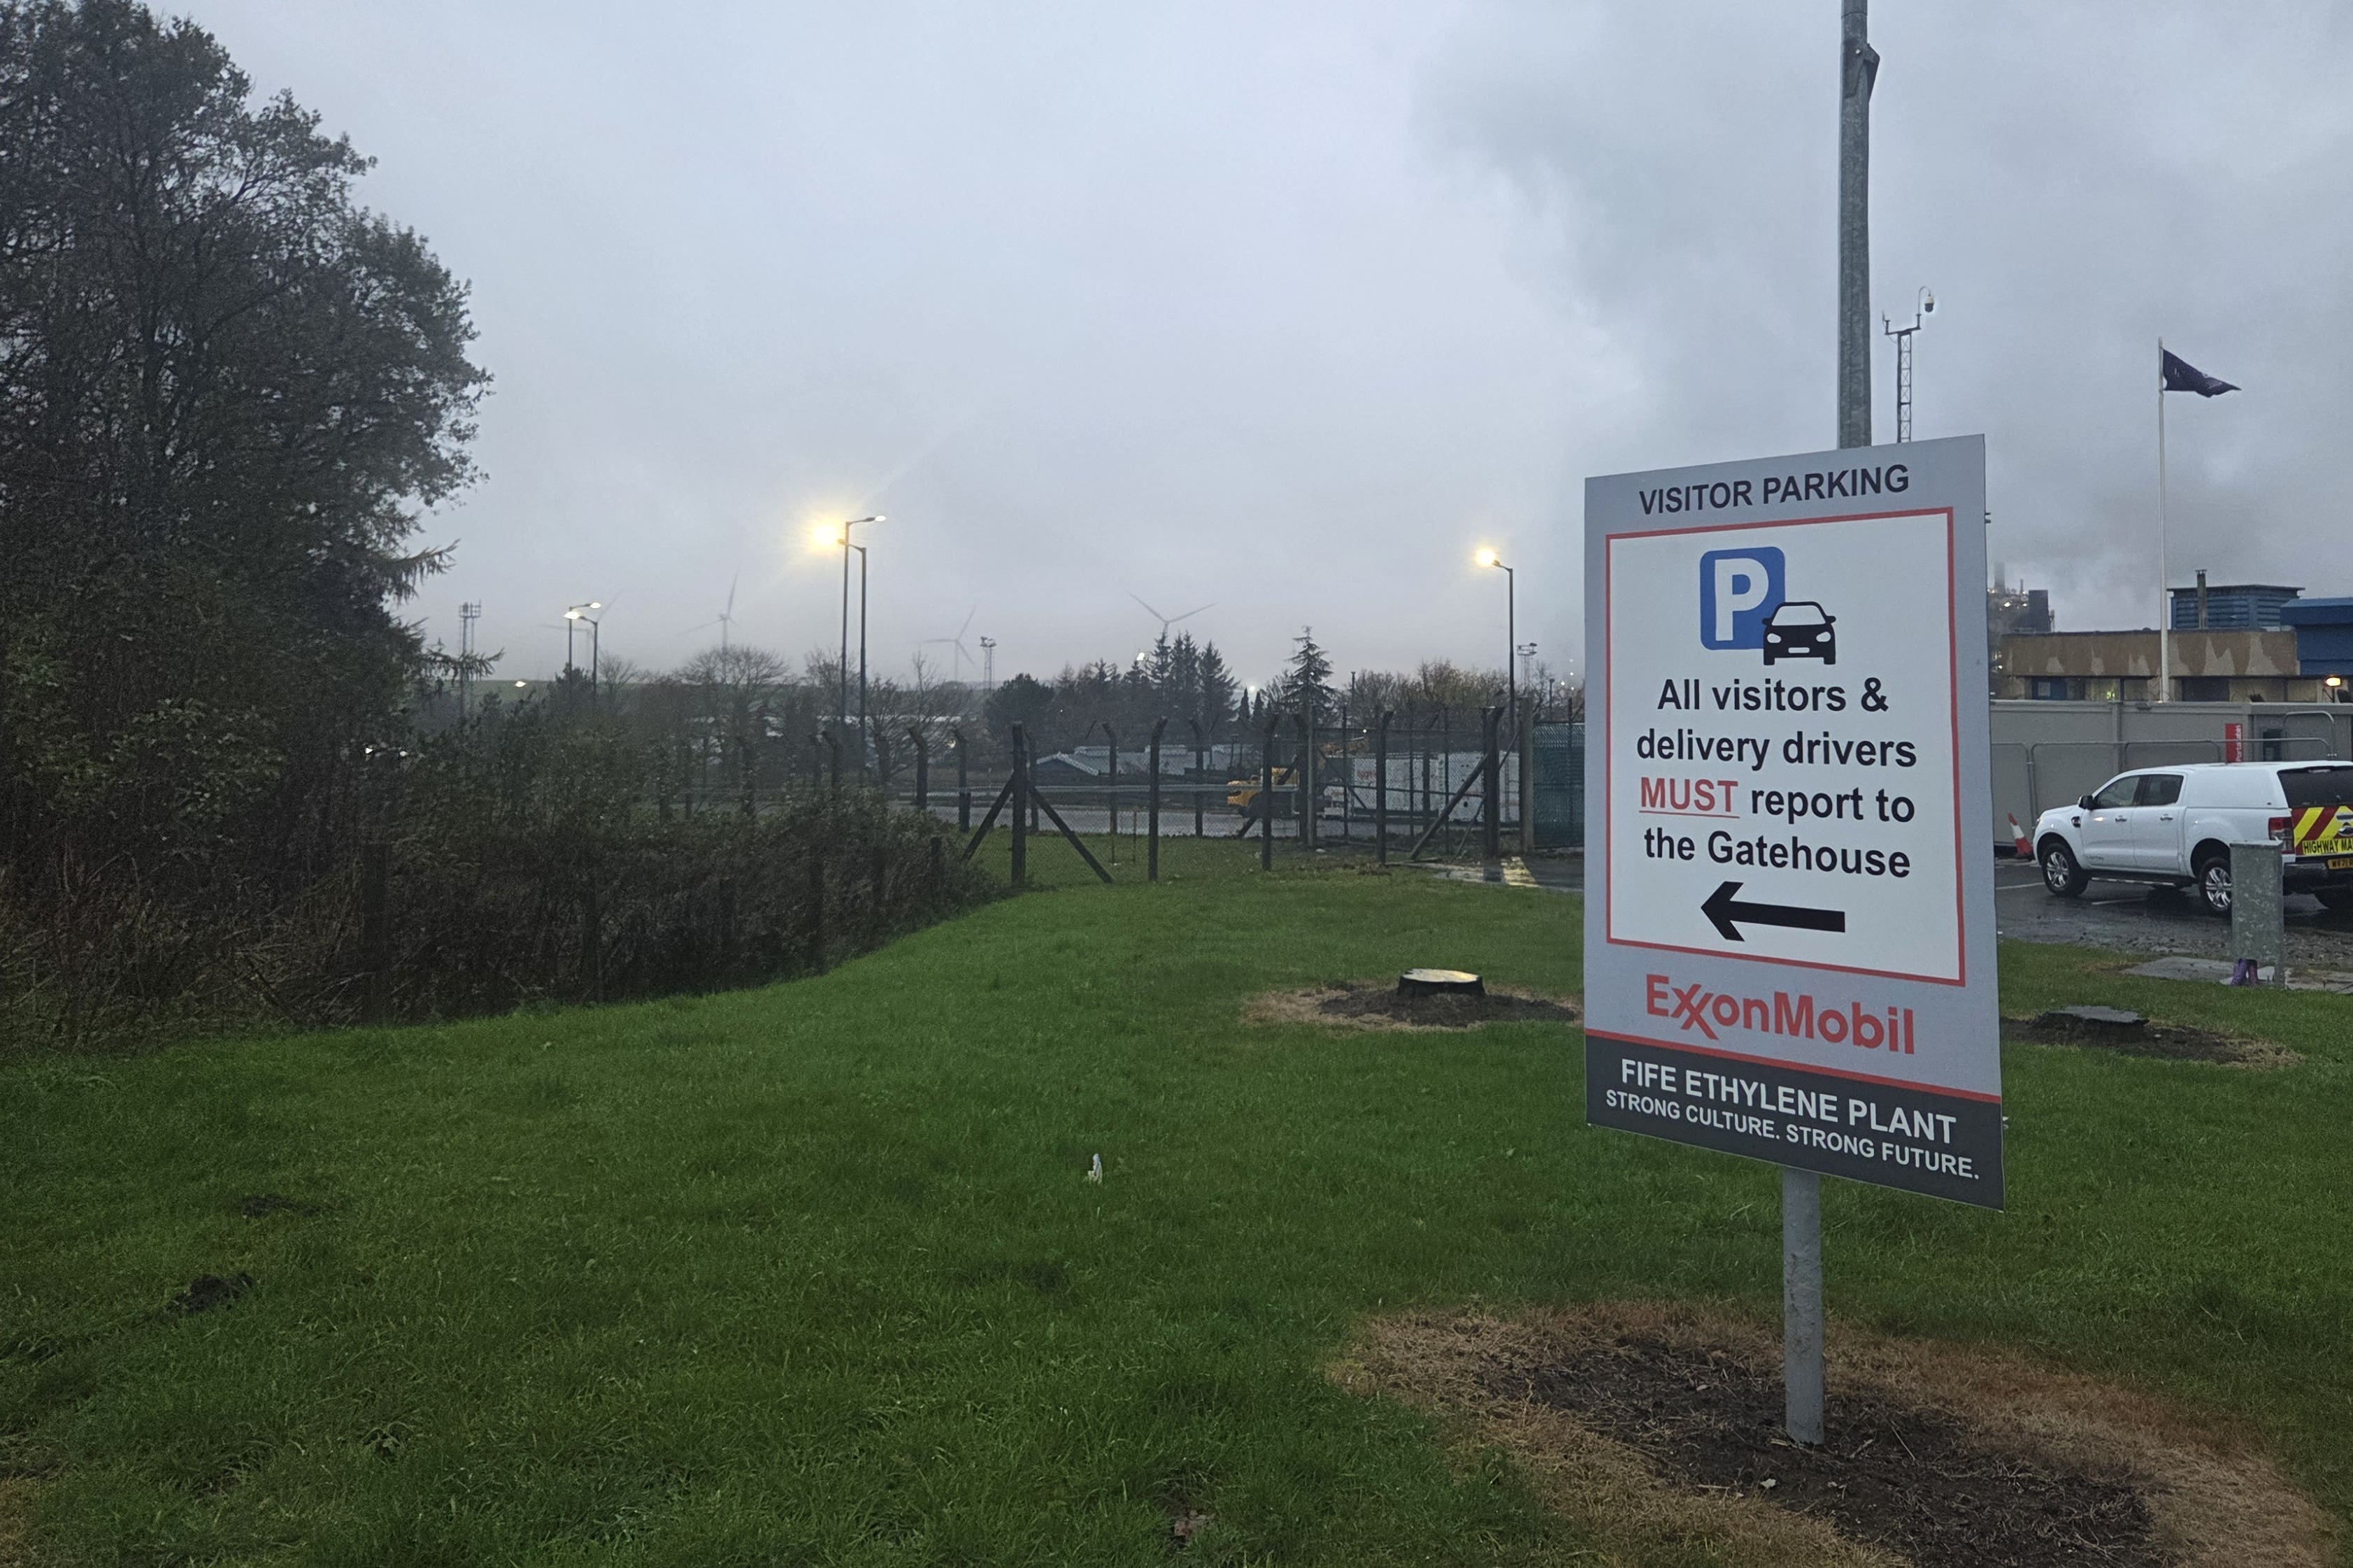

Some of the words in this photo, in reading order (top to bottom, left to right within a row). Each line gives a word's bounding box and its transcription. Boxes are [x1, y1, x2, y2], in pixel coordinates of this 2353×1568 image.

[1639, 480, 1752, 515] VISITOR
[1763, 465, 1909, 504] PARKING
[1715, 558, 1768, 641] P
[1657, 679, 1700, 710] All
[1712, 678, 1846, 711] visitors
[1861, 677, 1889, 712] &
[1637, 729, 1770, 770] delivery
[1782, 732, 1917, 768] drivers
[1640, 777, 1738, 812] MUST
[1752, 787, 1863, 823] report
[1876, 788, 1915, 822] to
[1644, 827, 1695, 862] the
[1708, 830, 1910, 877] Gatehouse
[2303, 840, 2338, 853] HIGHWAY
[2341, 839, 2353, 851] MA
[1646, 974, 1915, 1054] ExxonMobil
[1622, 1058, 1676, 1092] FIFE
[1685, 1070, 1838, 1123] ETHYLENE
[1849, 1099, 1957, 1144] PLANT
[1606, 1089, 1680, 1120] STRONG
[1685, 1105, 1780, 1140] CULTURE.
[1786, 1125, 1874, 1158] STRONG
[1882, 1142, 1980, 1179] FUTURE.
